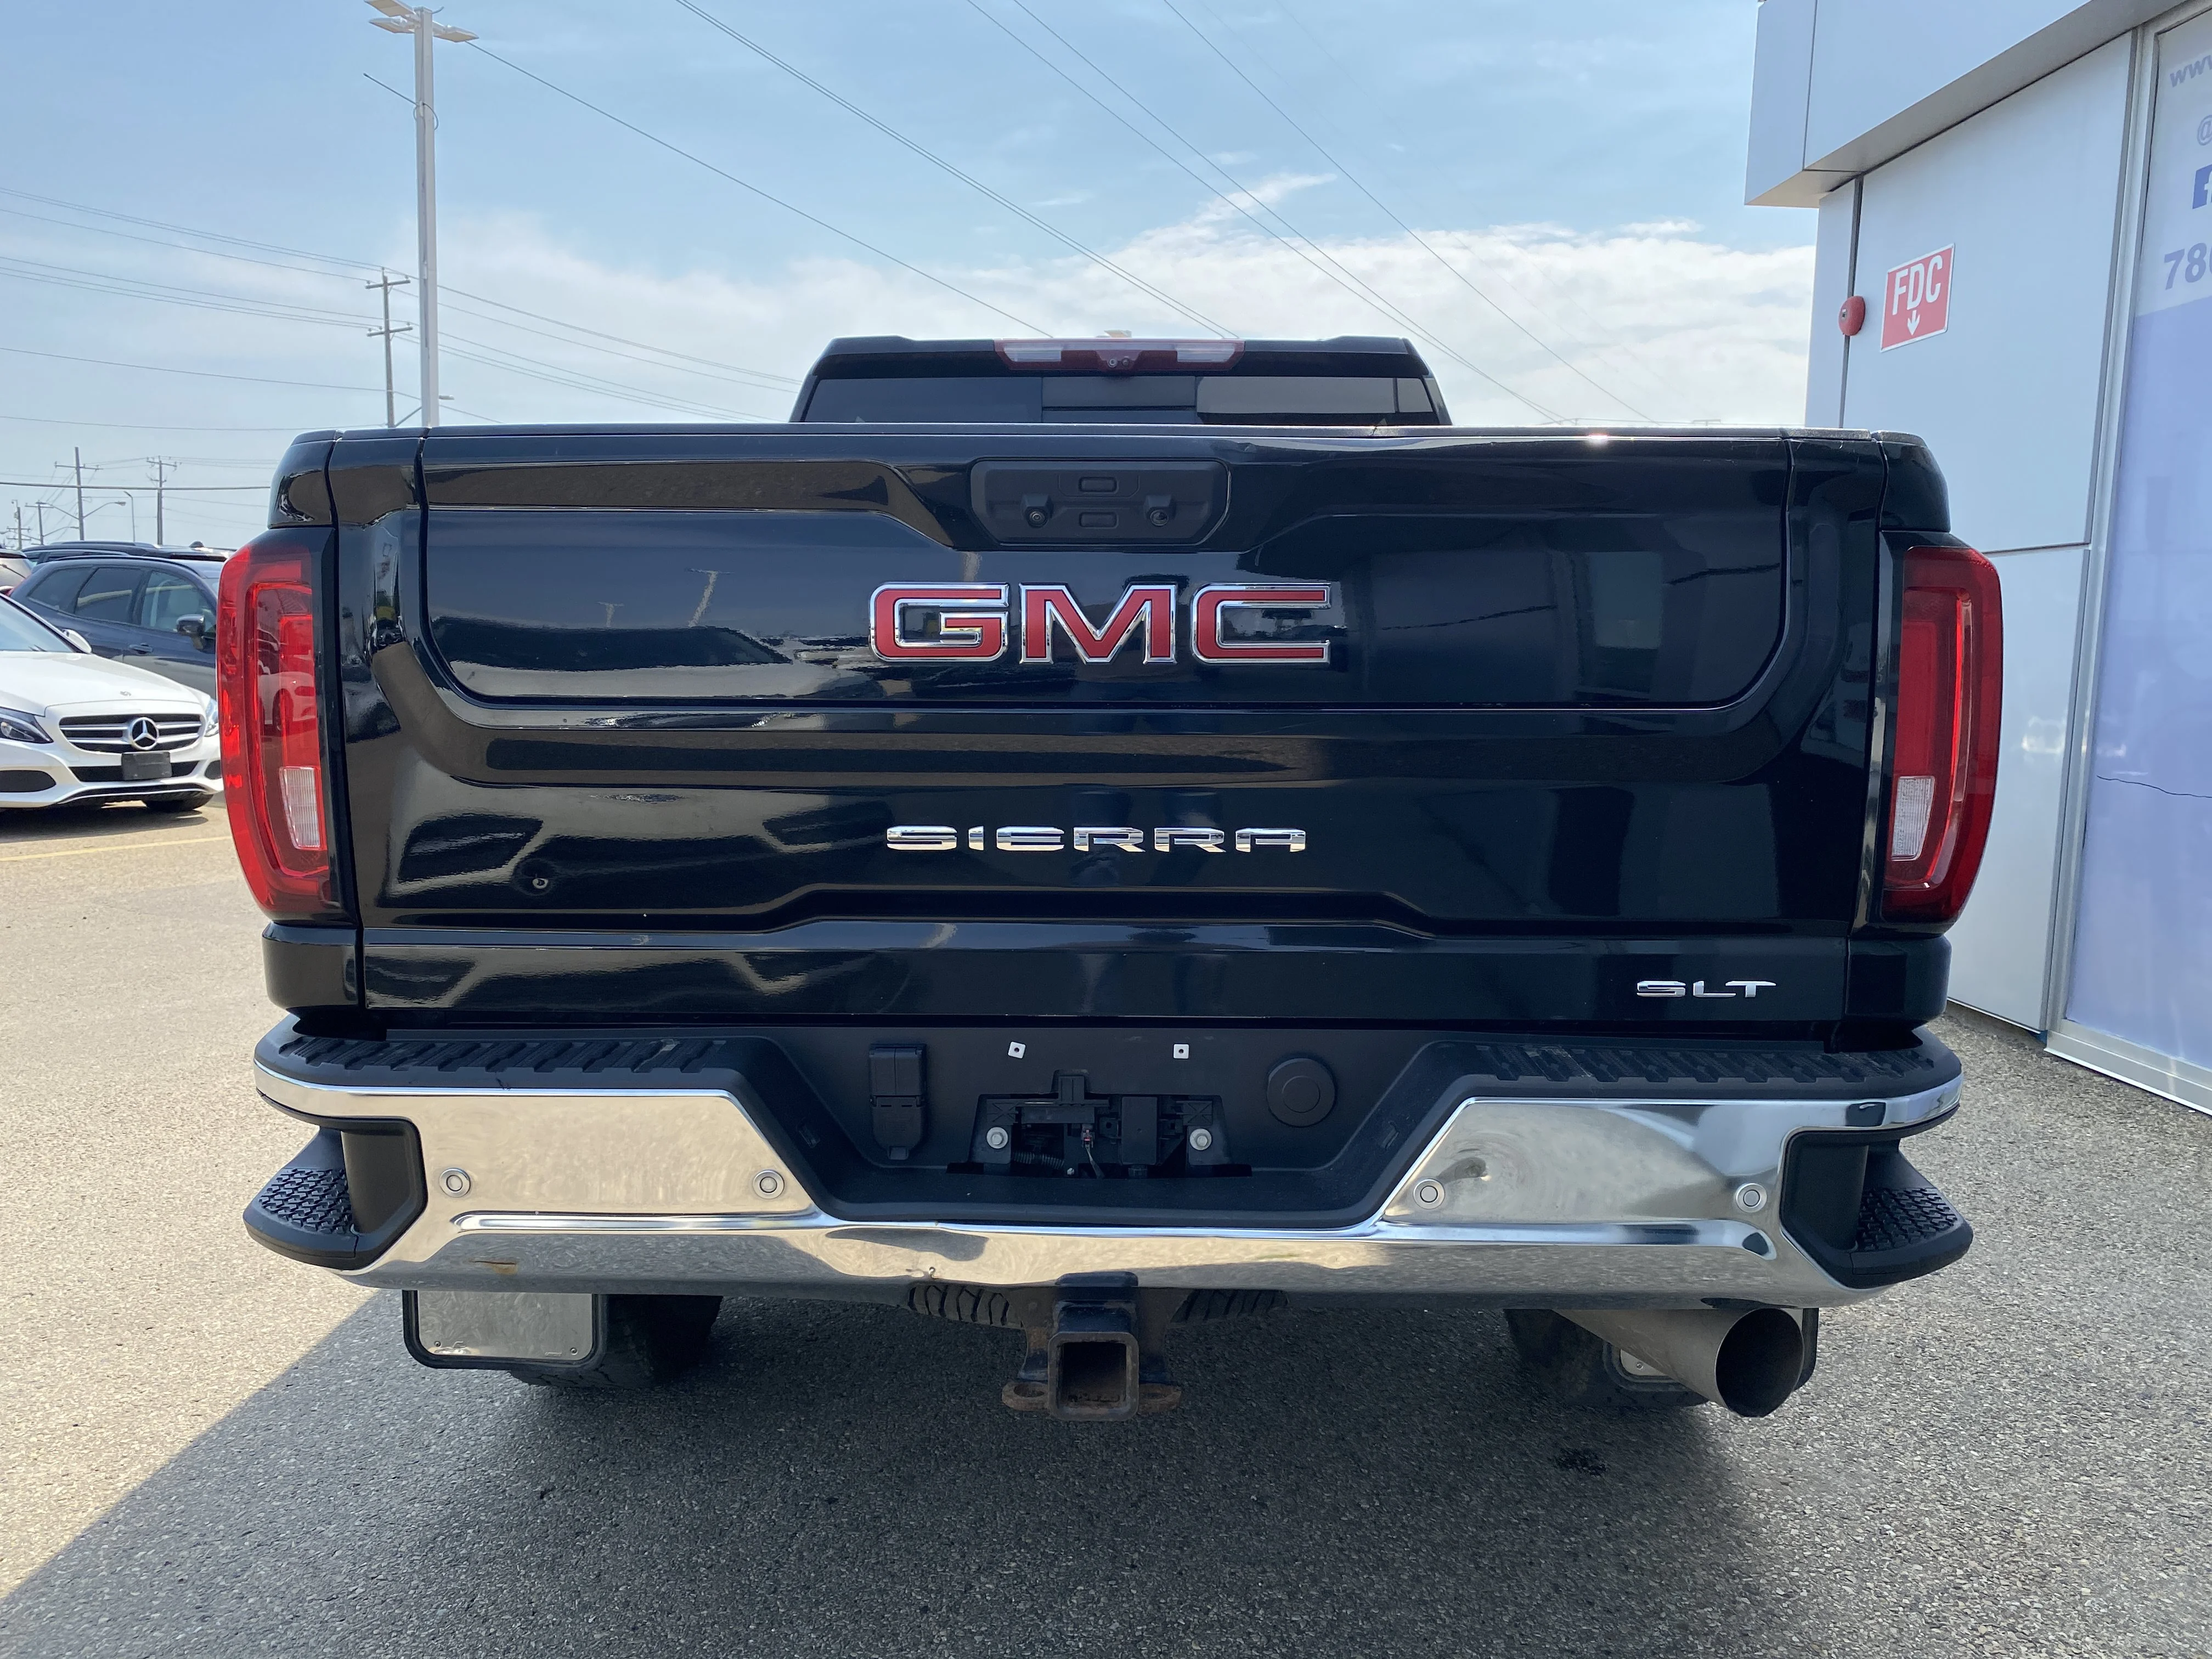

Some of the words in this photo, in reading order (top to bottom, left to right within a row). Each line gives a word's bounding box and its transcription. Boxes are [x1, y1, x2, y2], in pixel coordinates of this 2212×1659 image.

[2170, 54, 2212, 88] ww
[1892, 255, 1943, 315] FDC
[2164, 242, 2212, 290] 78
[869, 582, 1332, 664] GMC
[886, 825, 1307, 853] SIERRA
[1637, 980, 1776, 998] SLT
